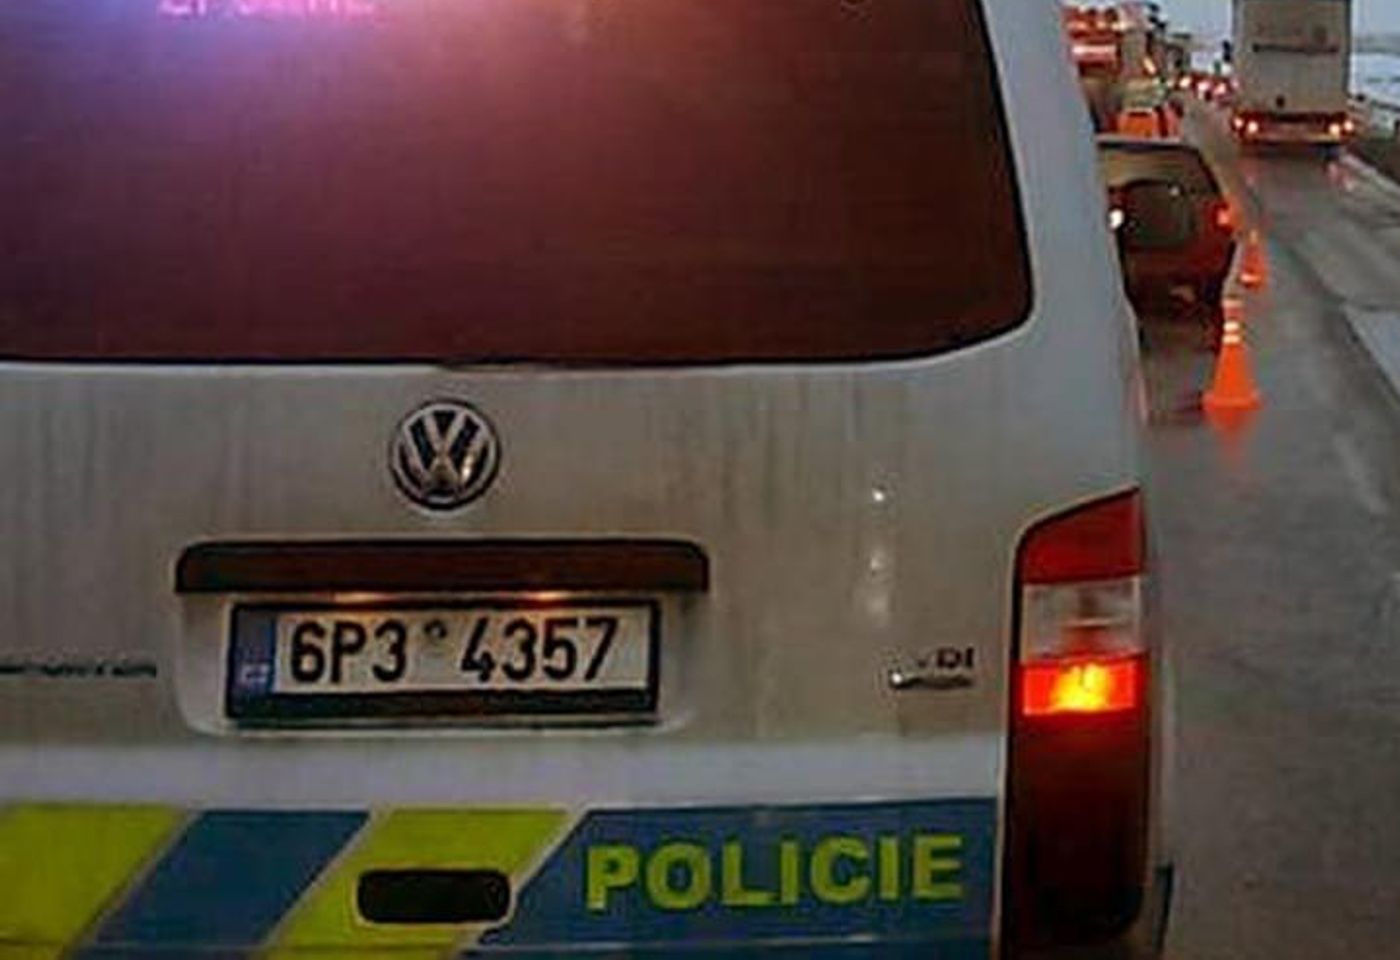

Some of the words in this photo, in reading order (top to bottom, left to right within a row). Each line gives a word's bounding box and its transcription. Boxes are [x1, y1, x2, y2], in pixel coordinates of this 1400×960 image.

[290, 619, 407, 684] 6P3
[460, 616, 620, 683] 4357
[585, 834, 965, 911] POLICIE
